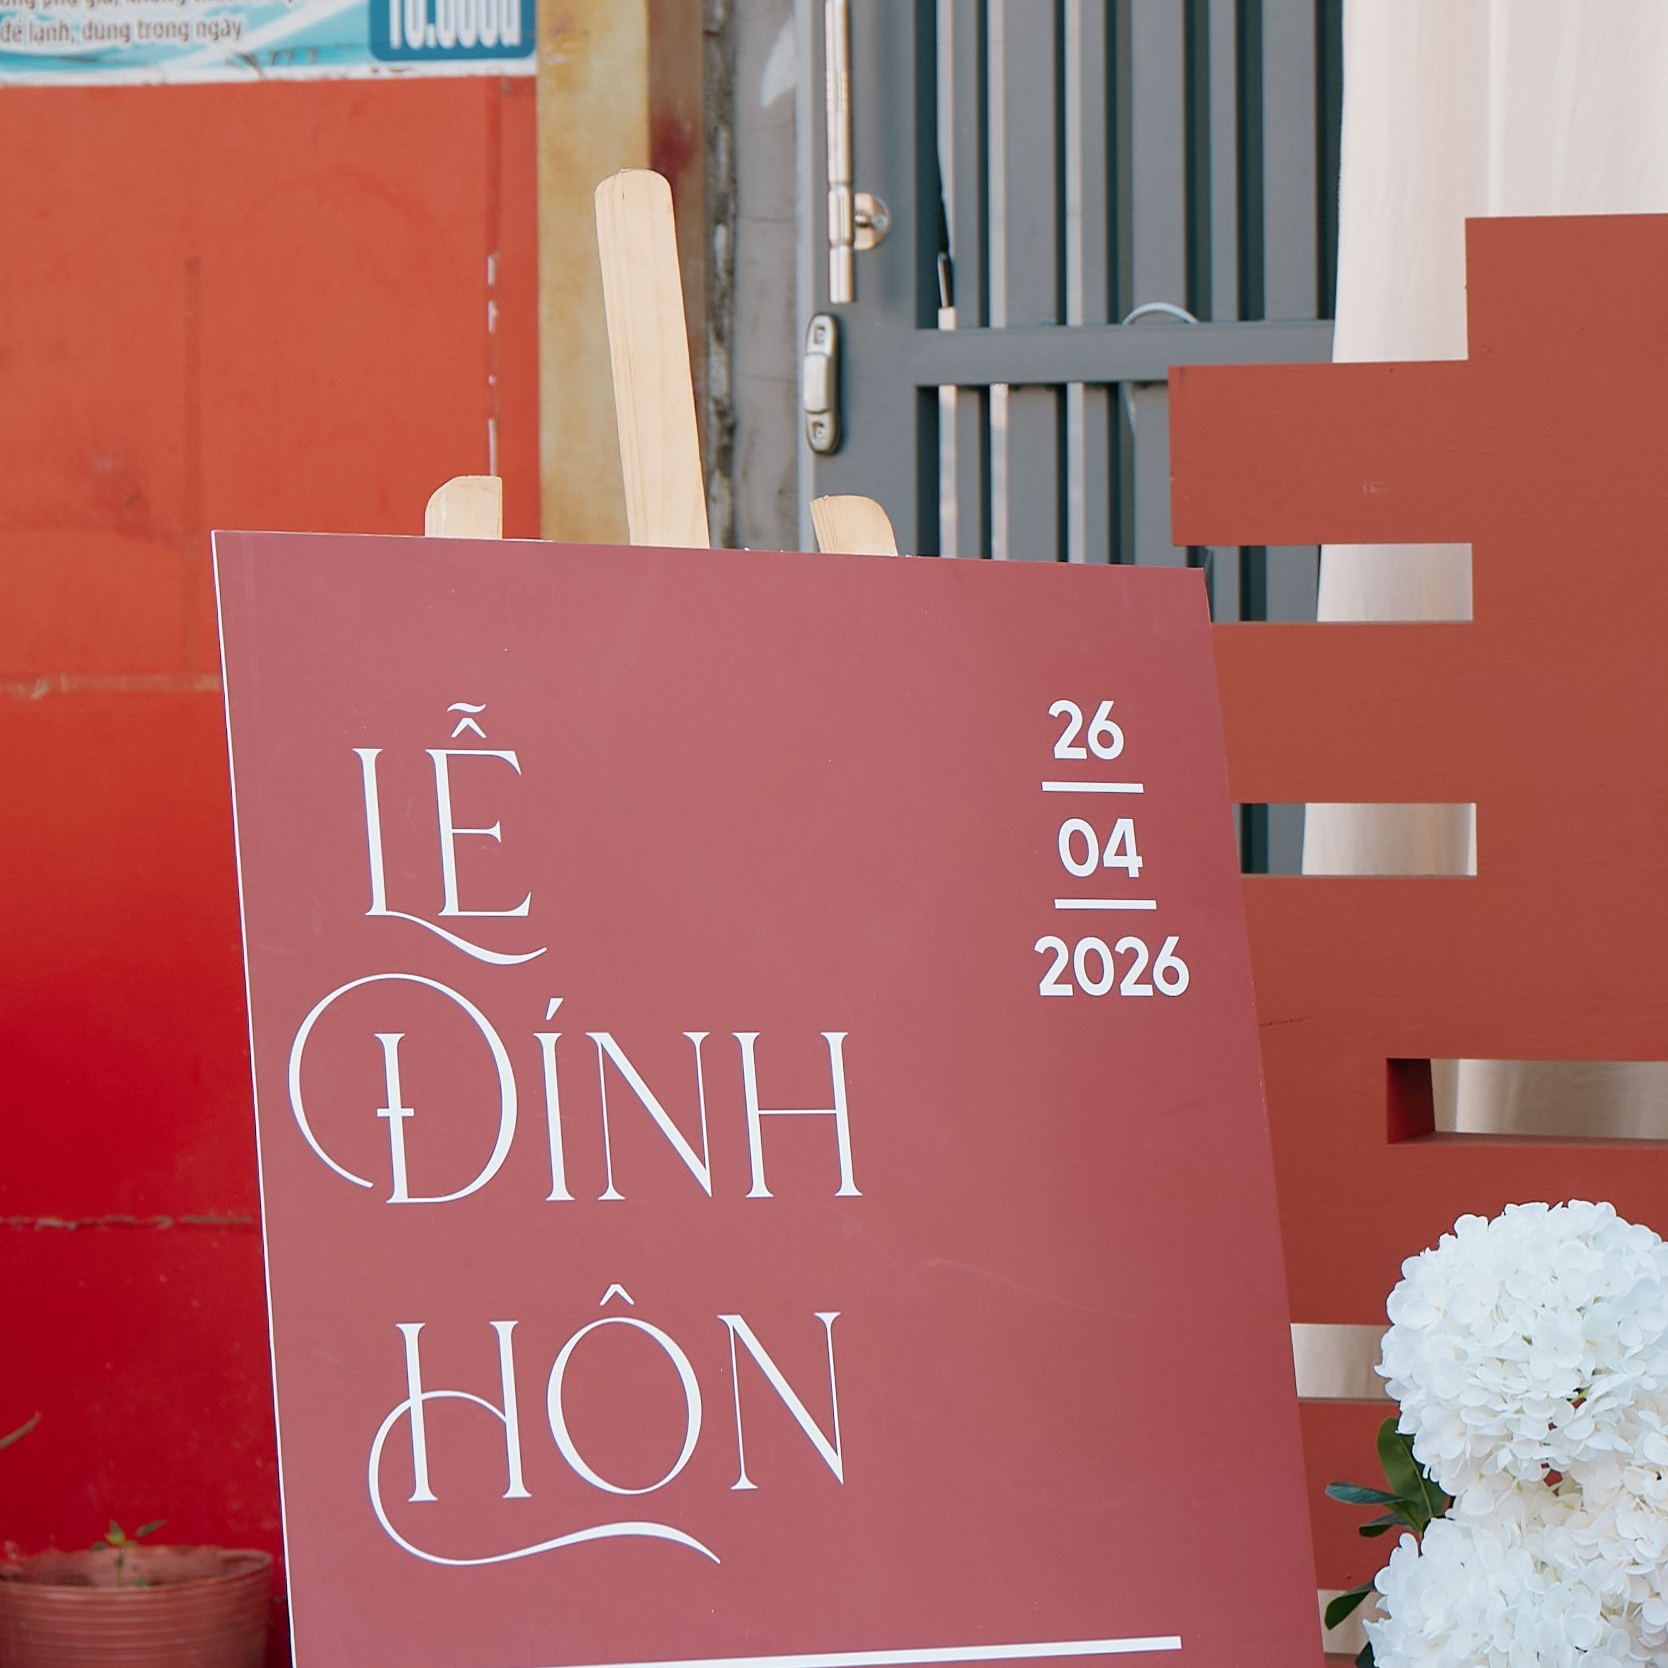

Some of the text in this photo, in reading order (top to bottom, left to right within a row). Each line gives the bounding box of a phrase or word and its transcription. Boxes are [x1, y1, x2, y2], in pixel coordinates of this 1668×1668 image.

[82, 17, 131, 44] dùng
[137, 17, 190, 42] trong
[196, 16, 242, 40] ngày
[1049, 700, 1126, 761] 26
[353, 703, 549, 966] LỄ
[1059, 819, 1145, 879] 04
[1035, 936, 1191, 998] 2026
[289, 973, 864, 1205] ĐÍNH
[369, 1284, 845, 1567] HÔN
